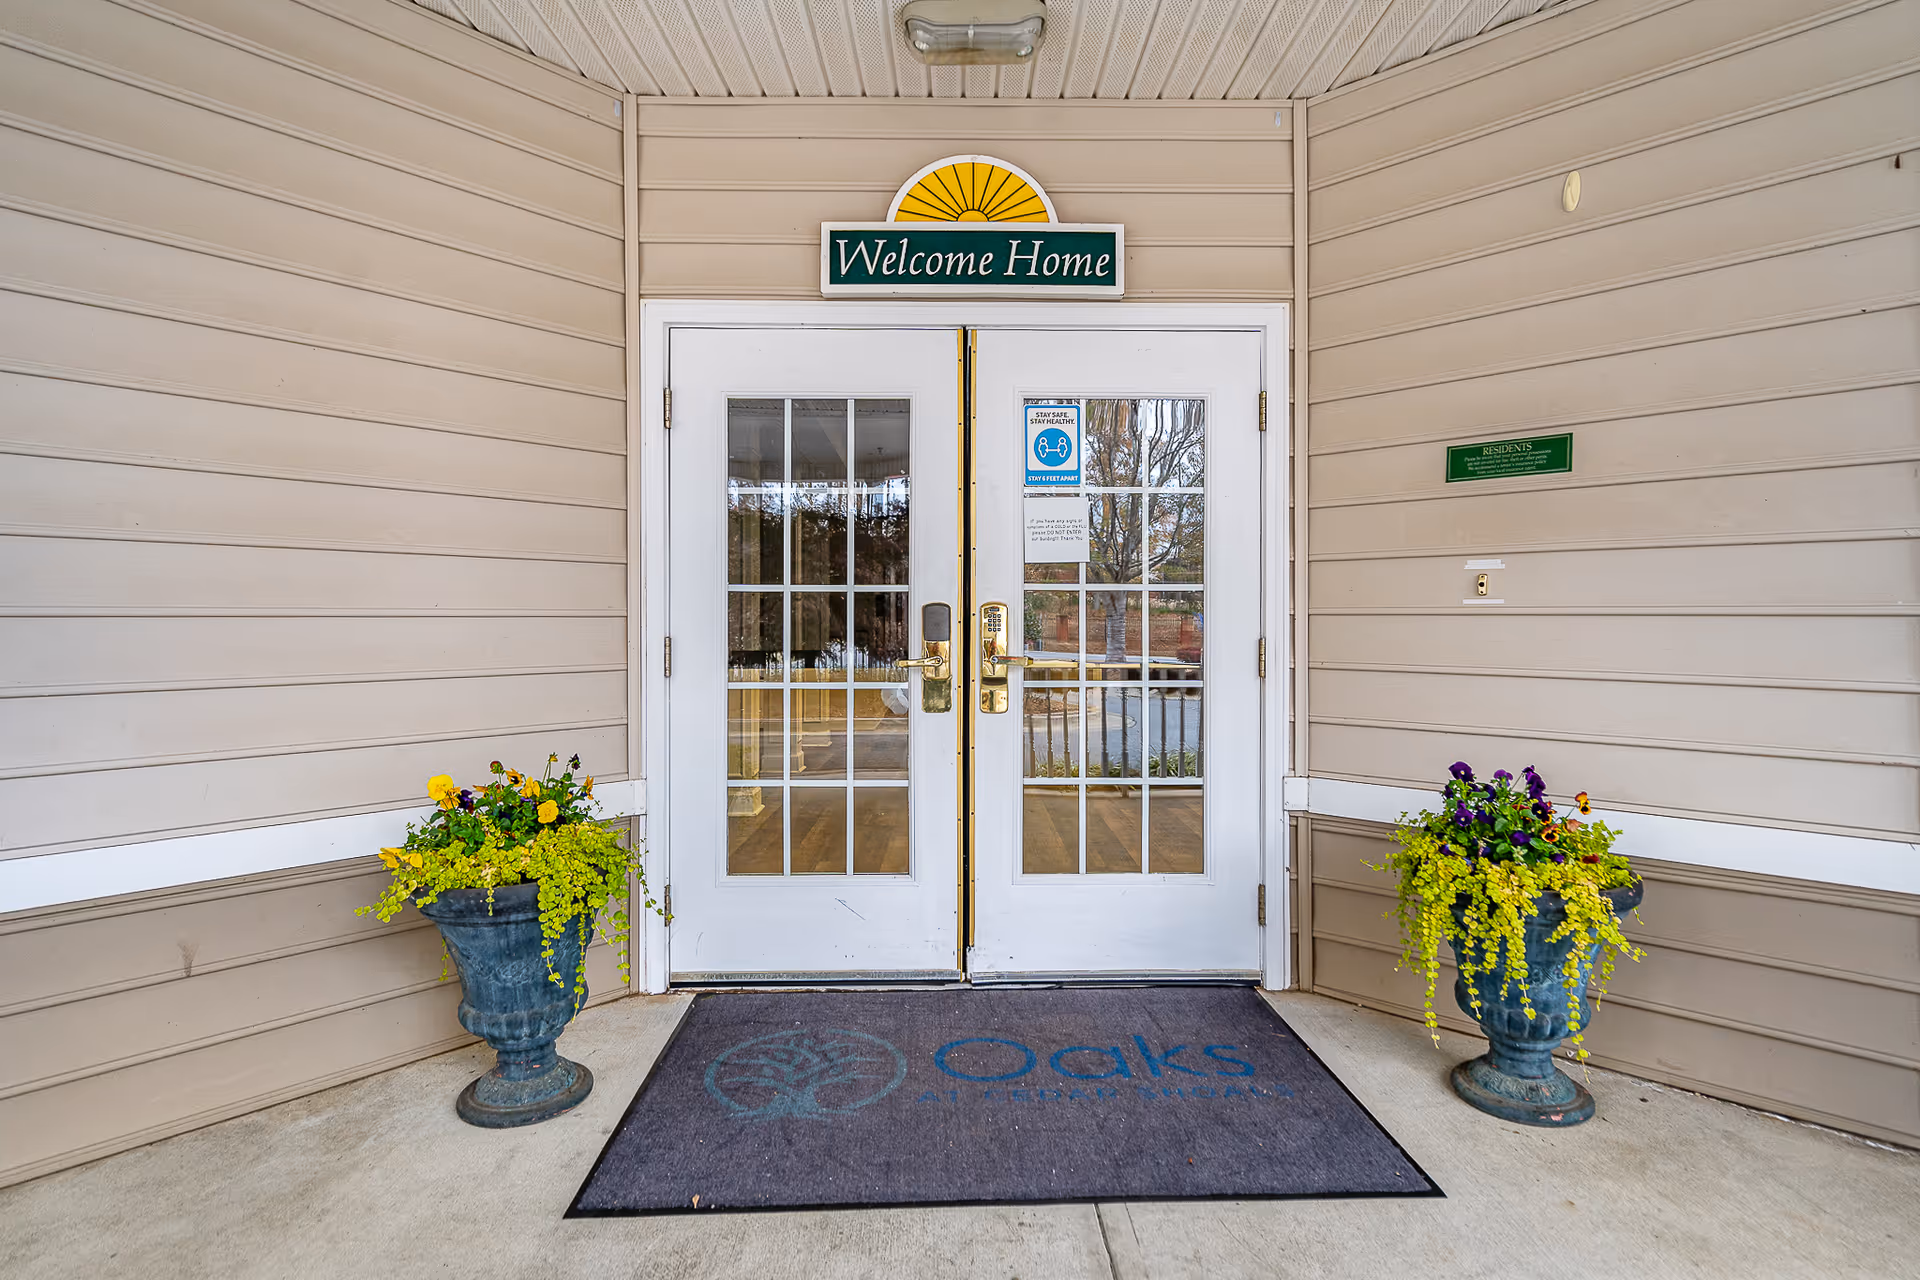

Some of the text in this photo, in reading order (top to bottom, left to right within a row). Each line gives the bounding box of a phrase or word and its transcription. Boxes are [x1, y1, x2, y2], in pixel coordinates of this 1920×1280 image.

[835, 237, 1110, 277] Welcome Home
[1483, 442, 1532, 455] RESIDENTS
[934, 1035, 1255, 1084] Oaks
